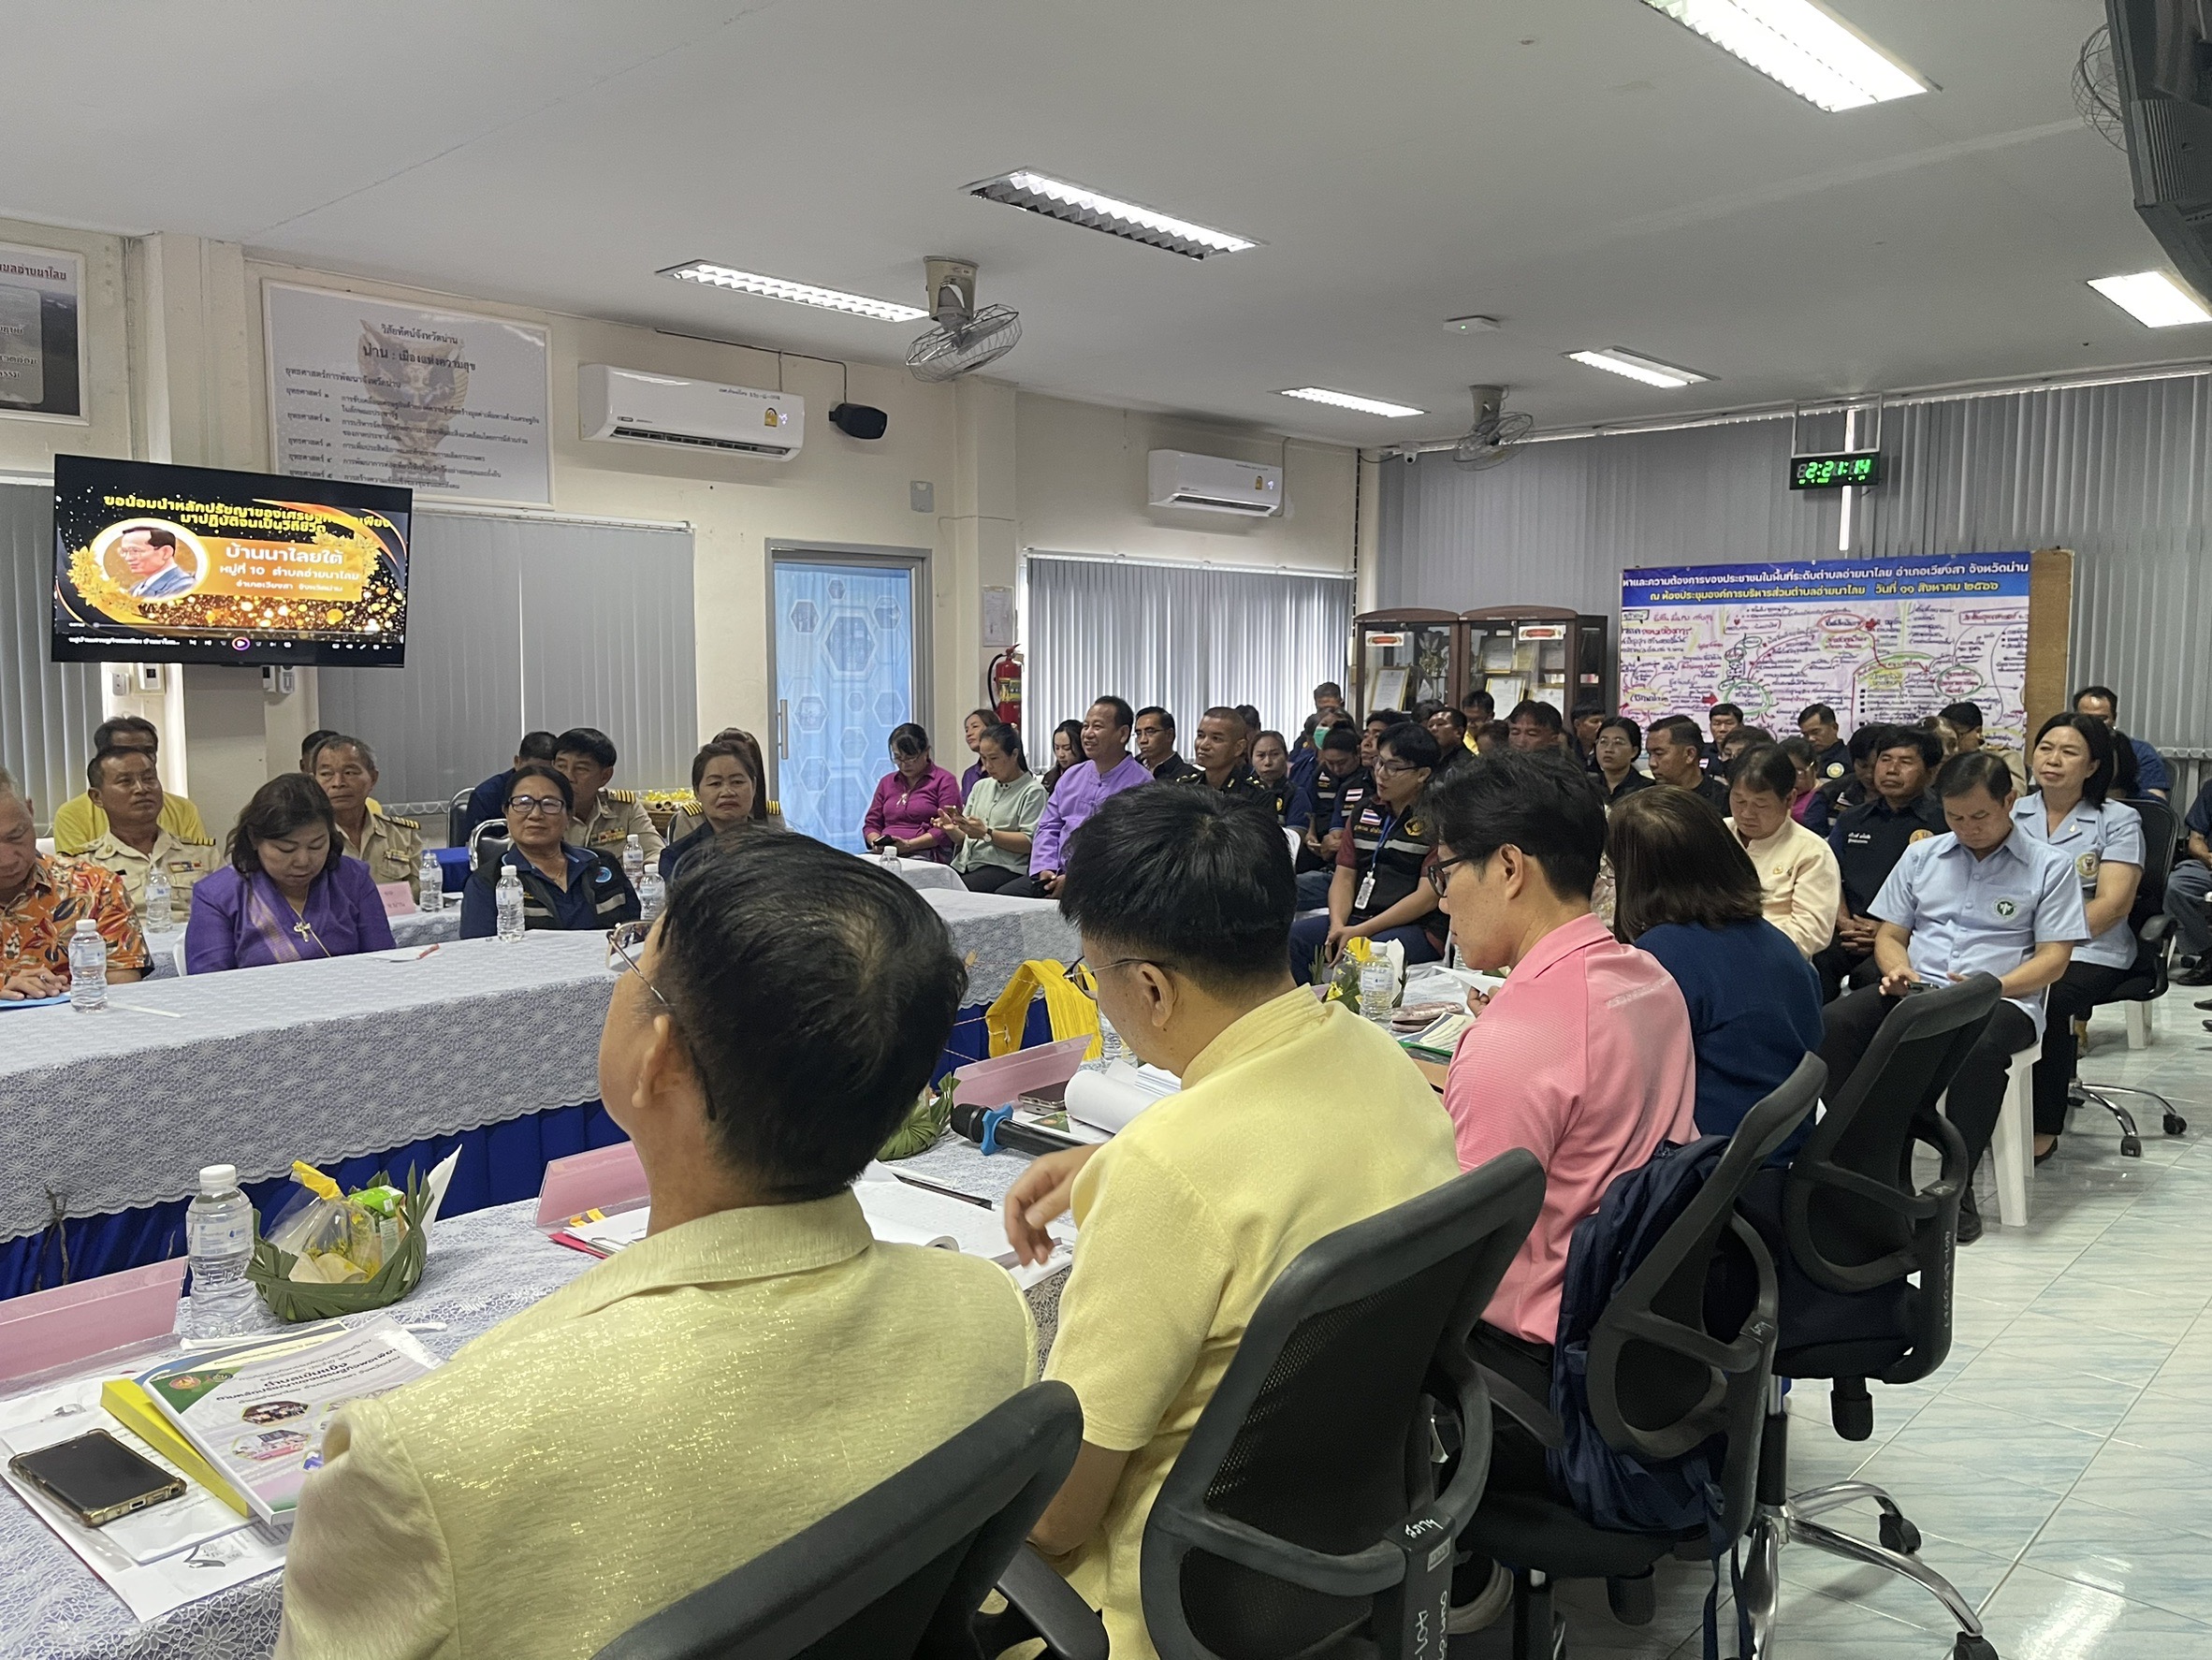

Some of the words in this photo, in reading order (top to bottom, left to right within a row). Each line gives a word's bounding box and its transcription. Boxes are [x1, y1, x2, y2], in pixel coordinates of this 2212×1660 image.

[1805, 459, 1870, 479] 2:21:14
[226, 543, 343, 564] บ้านนาไลยใต้
[220, 563, 245, 576] หมู่ที่
[250, 566, 265, 575] 10
[1896, 563, 1965, 577] อำเภอเวียงสา
[1969, 561, 2029, 574] จังหวัดน่าน
[1650, 592, 1660, 601] ณ
[1875, 581, 1897, 594] วันที่
[1917, 581, 1960, 593] สิงหาคม
